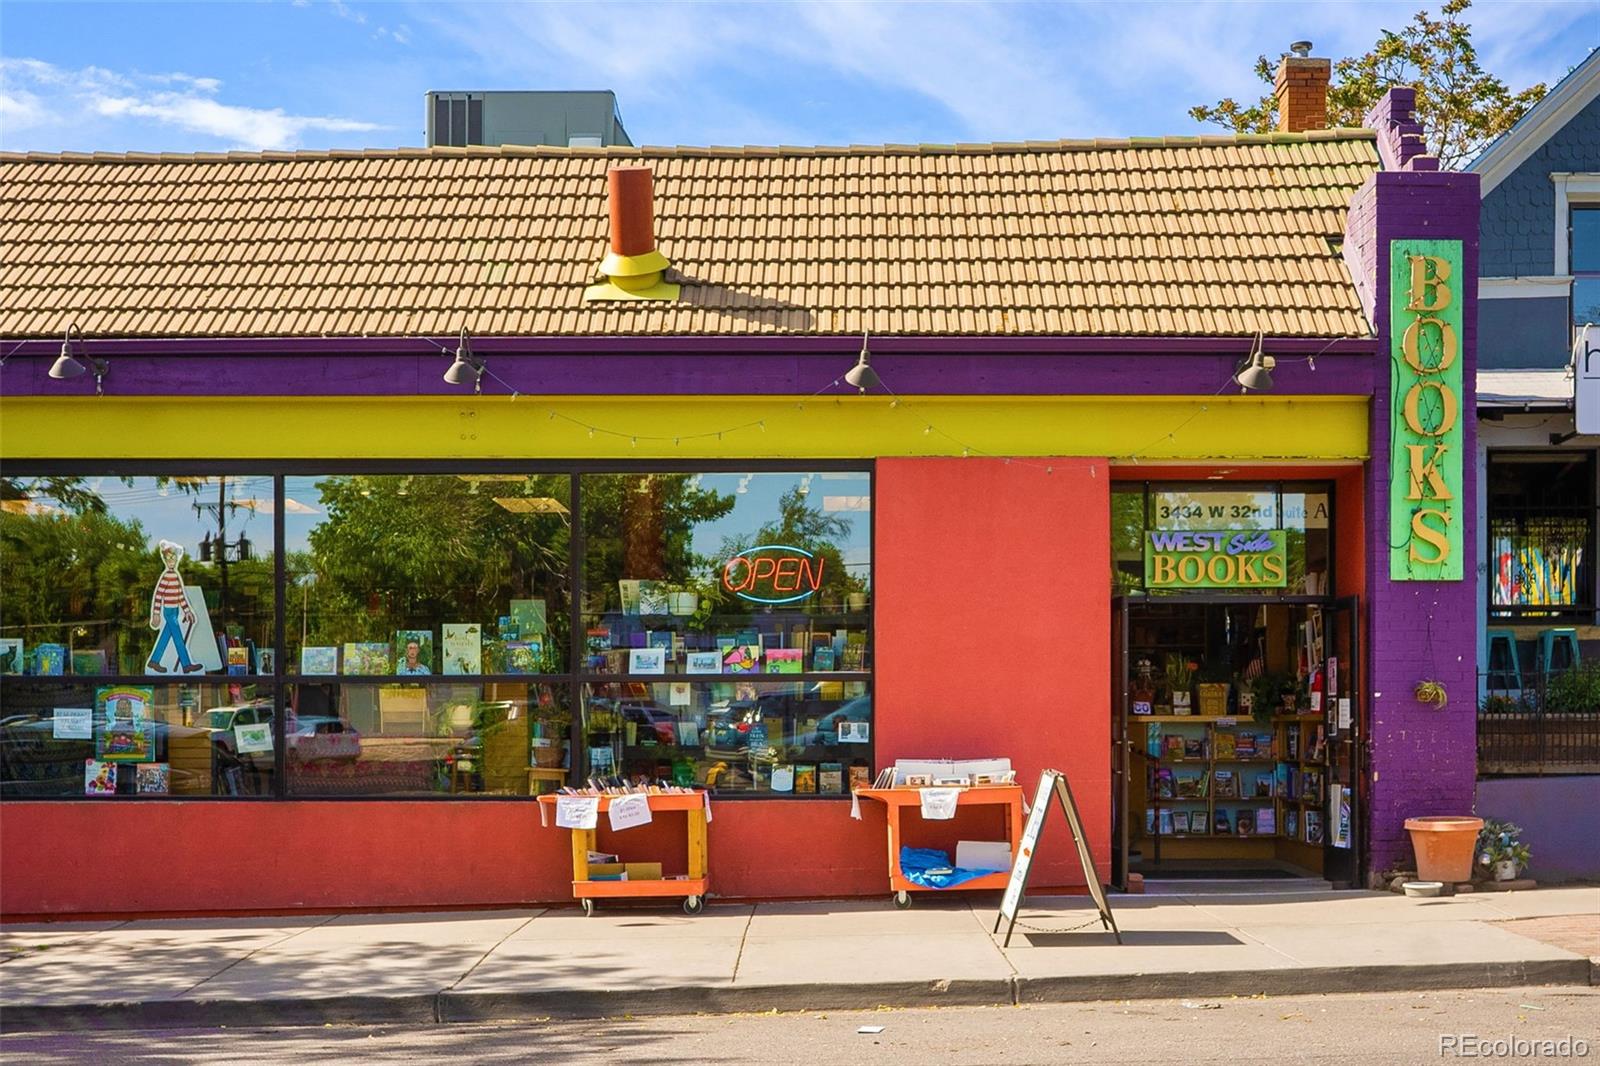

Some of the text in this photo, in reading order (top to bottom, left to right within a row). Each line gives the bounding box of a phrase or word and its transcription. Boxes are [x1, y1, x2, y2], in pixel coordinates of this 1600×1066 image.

[1403, 254, 1457, 564] BOOKS
[1160, 506, 1203, 519] 3434
[1208, 506, 1224, 518] W
[1230, 505, 1273, 519] 32nd
[1313, 502, 1328, 519] A
[1151, 531, 1276, 555] WEST Side
[723, 556, 824, 592] OPEN
[1152, 553, 1284, 584] BOOKS
